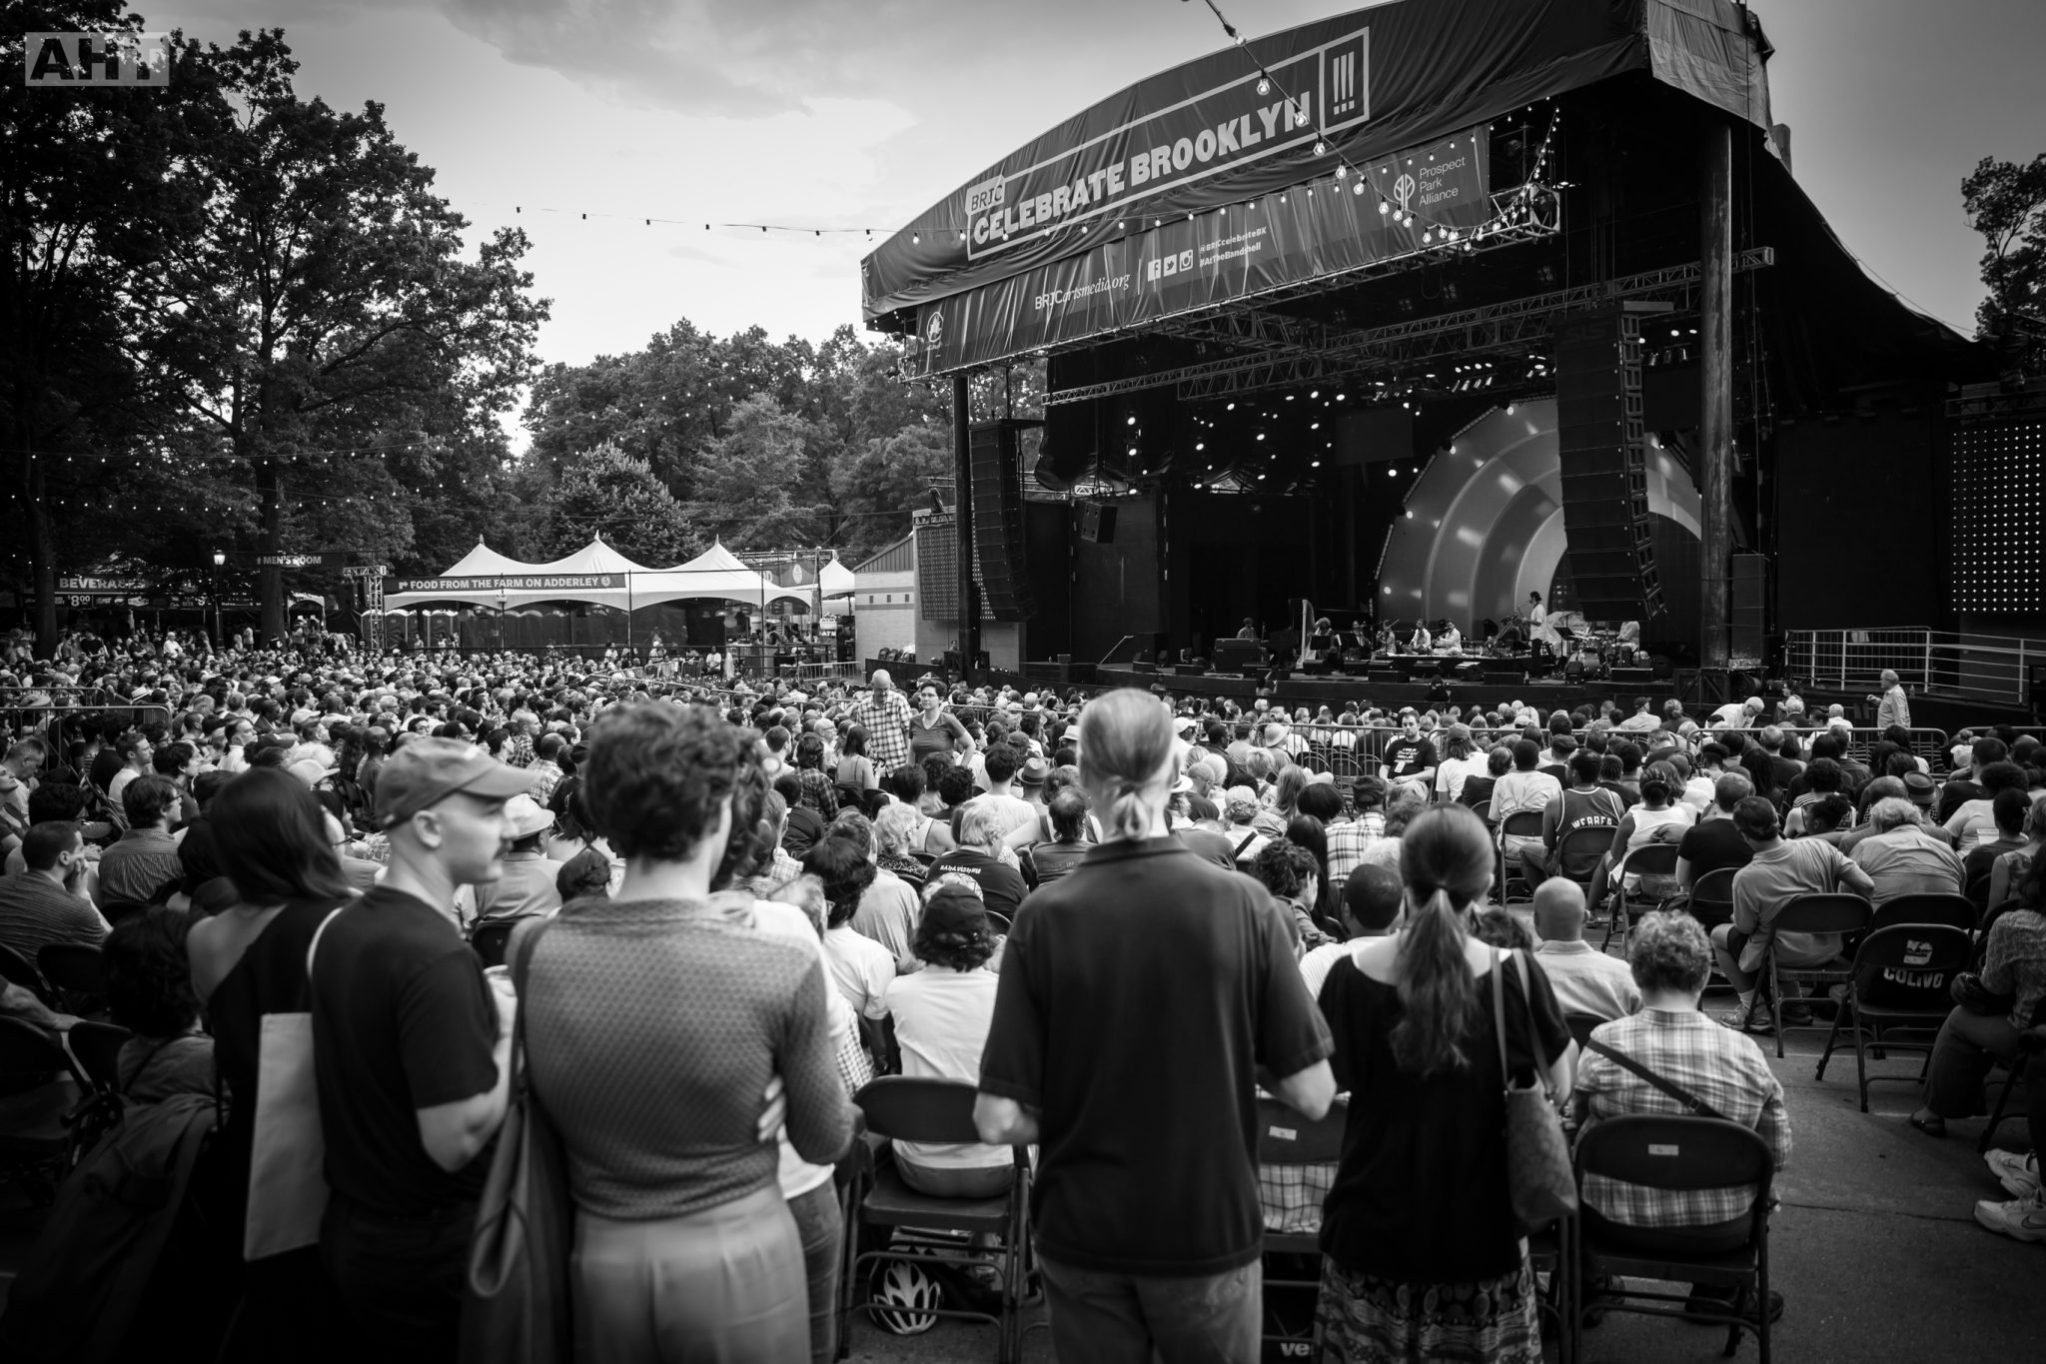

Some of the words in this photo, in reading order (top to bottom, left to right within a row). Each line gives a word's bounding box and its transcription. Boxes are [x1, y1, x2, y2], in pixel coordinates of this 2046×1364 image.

[973, 163, 1125, 245] CELEBRATE
[1131, 91, 1310, 187] BROOKLYN
[1419, 157, 1466, 179] Prospect
[1419, 177, 1442, 193] Park
[971, 184, 1003, 211] BRIC
[1419, 188, 1458, 207] Alliance
[263, 556, 290, 565] MEN'S
[293, 555, 322, 566] ROOM
[410, 581, 437, 589] FOOD
[440, 580, 469, 589] FROM
[472, 579, 492, 588] THE
[494, 579, 523, 588] FARM
[526, 579, 541, 587] ON
[543, 577, 599, 587] ADDERLEY
